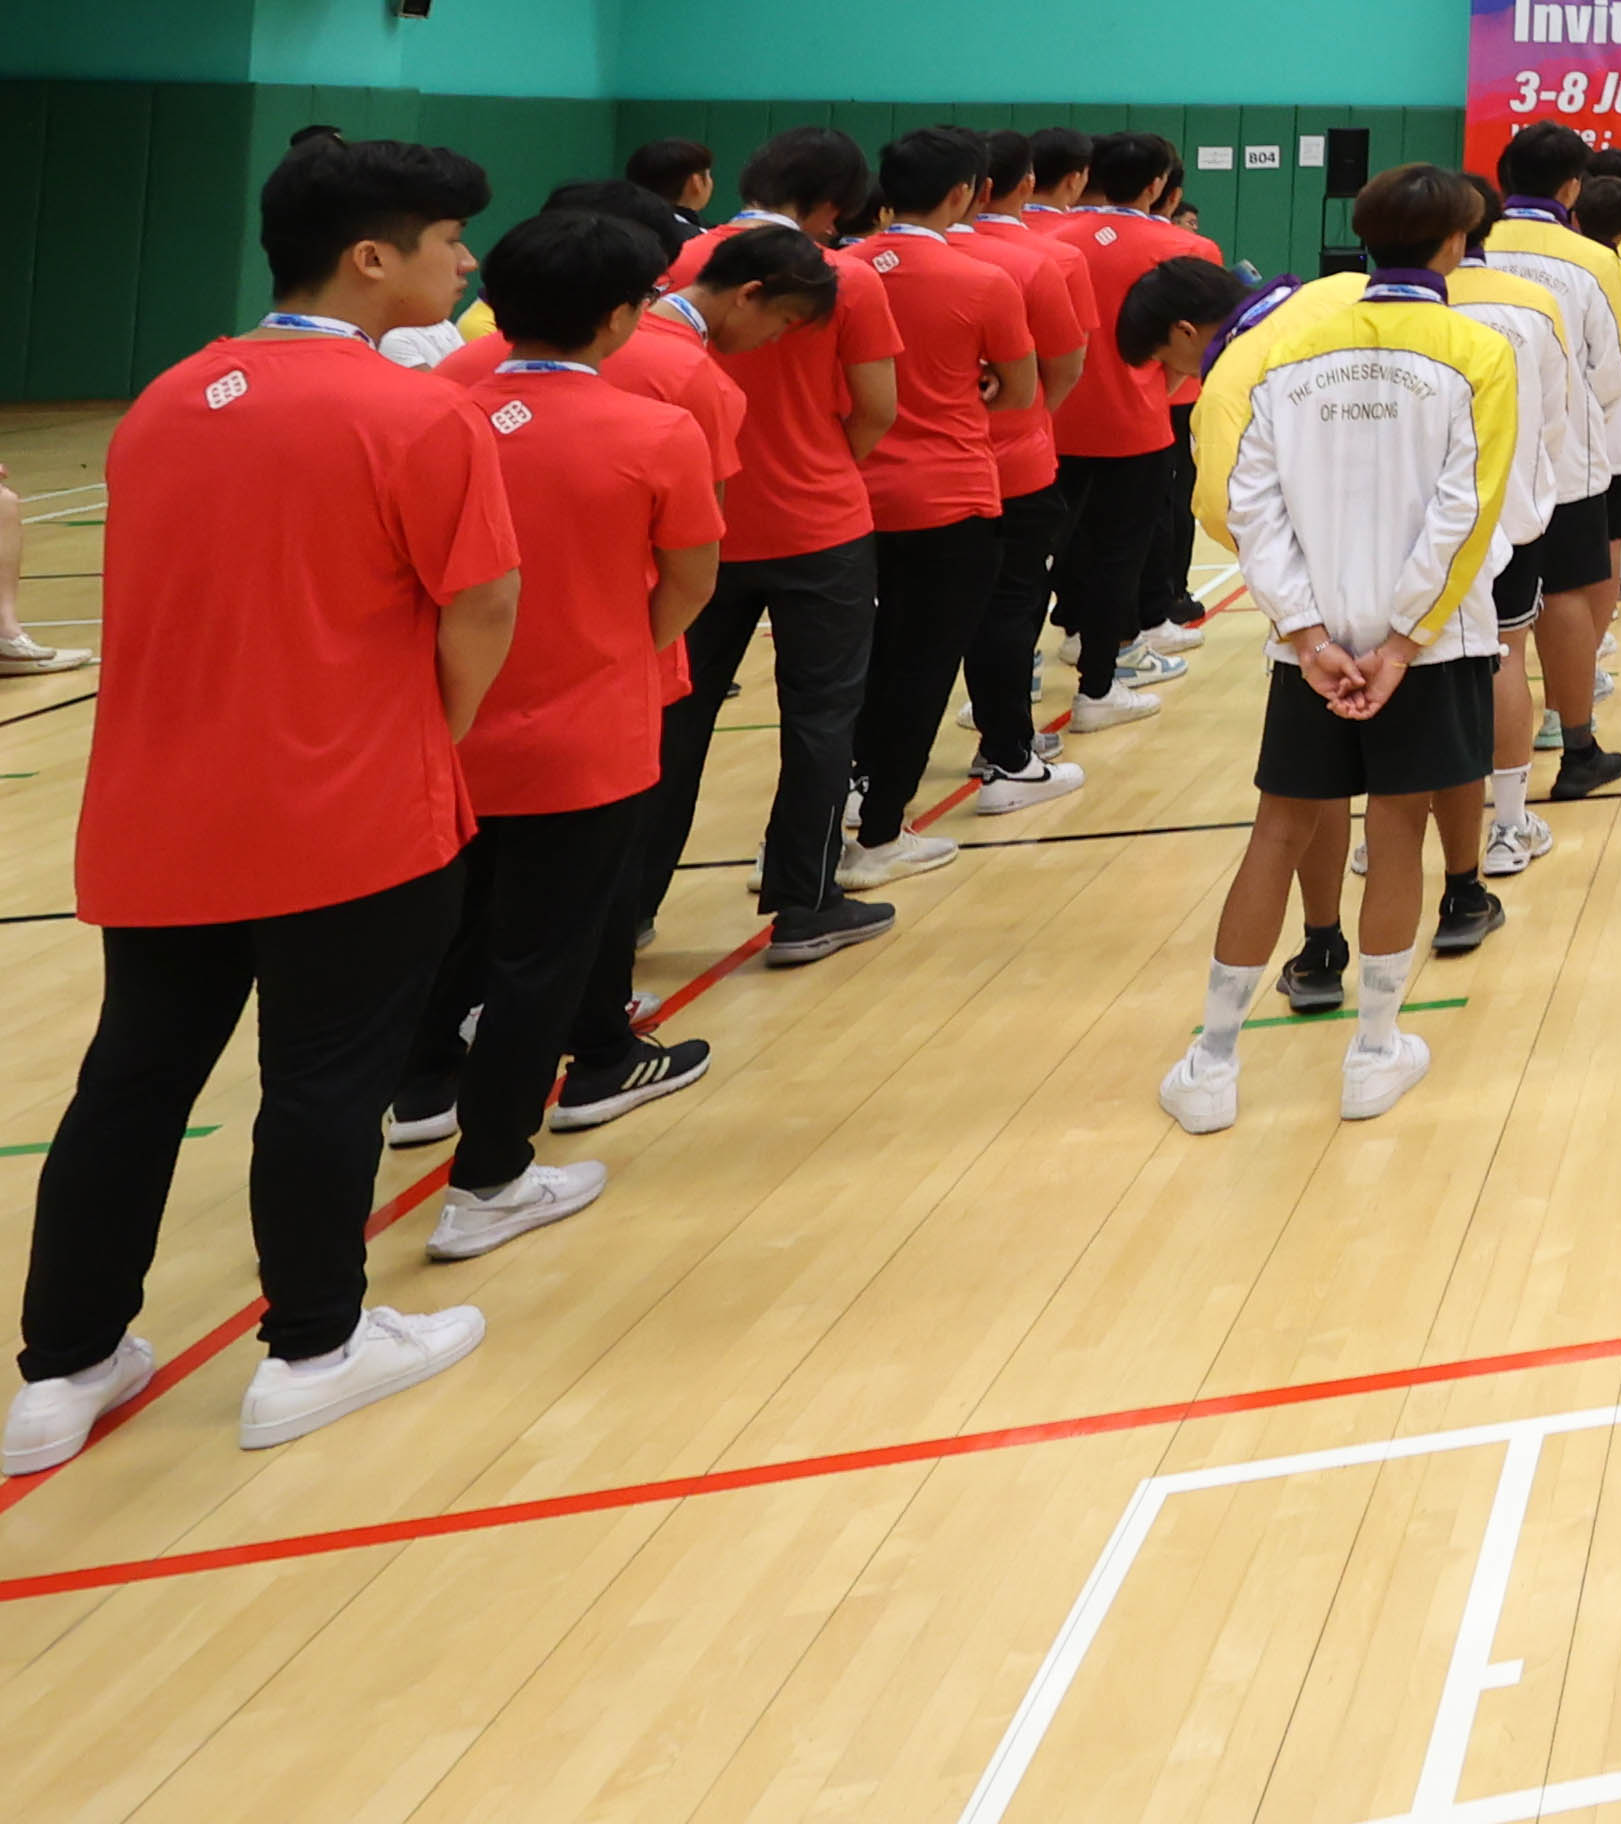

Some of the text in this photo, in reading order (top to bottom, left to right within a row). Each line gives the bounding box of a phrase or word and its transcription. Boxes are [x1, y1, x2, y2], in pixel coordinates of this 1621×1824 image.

[1509, 70, 1586, 114] 3-8
[1287, 381, 1313, 407] THE
[1320, 402, 1338, 422] OF
